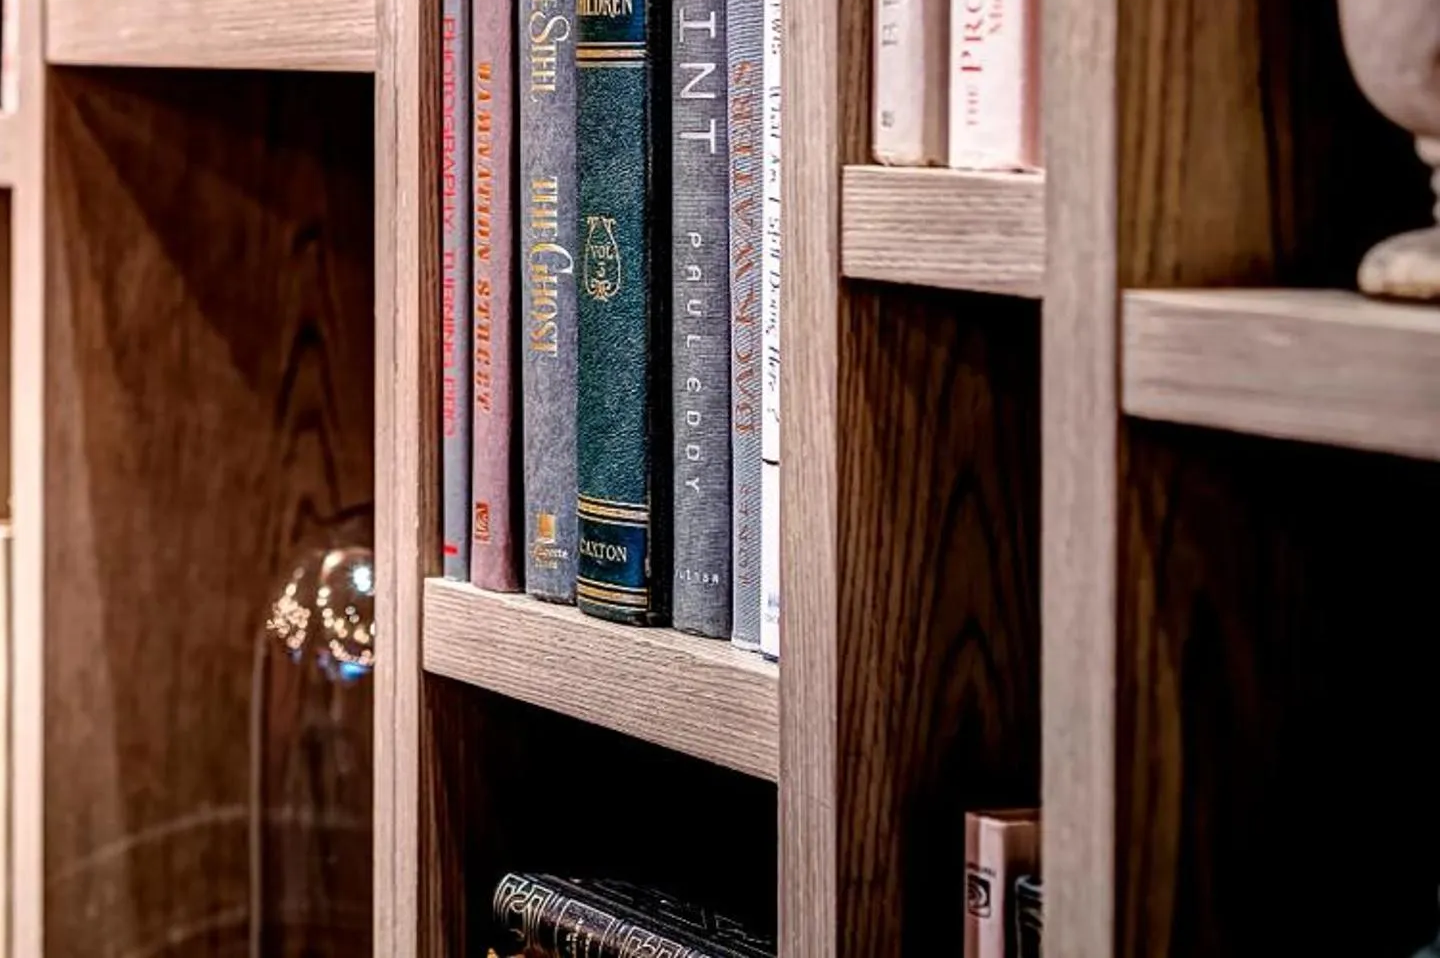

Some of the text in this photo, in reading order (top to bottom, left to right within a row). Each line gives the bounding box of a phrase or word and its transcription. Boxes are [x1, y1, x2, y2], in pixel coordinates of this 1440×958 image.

[528, 8, 571, 103] STEEL
[527, 174, 573, 357] THE GHOST
[686, 232, 703, 350] PAUL
[476, 278, 492, 412] STREET
[579, 537, 628, 563] CAXTON
